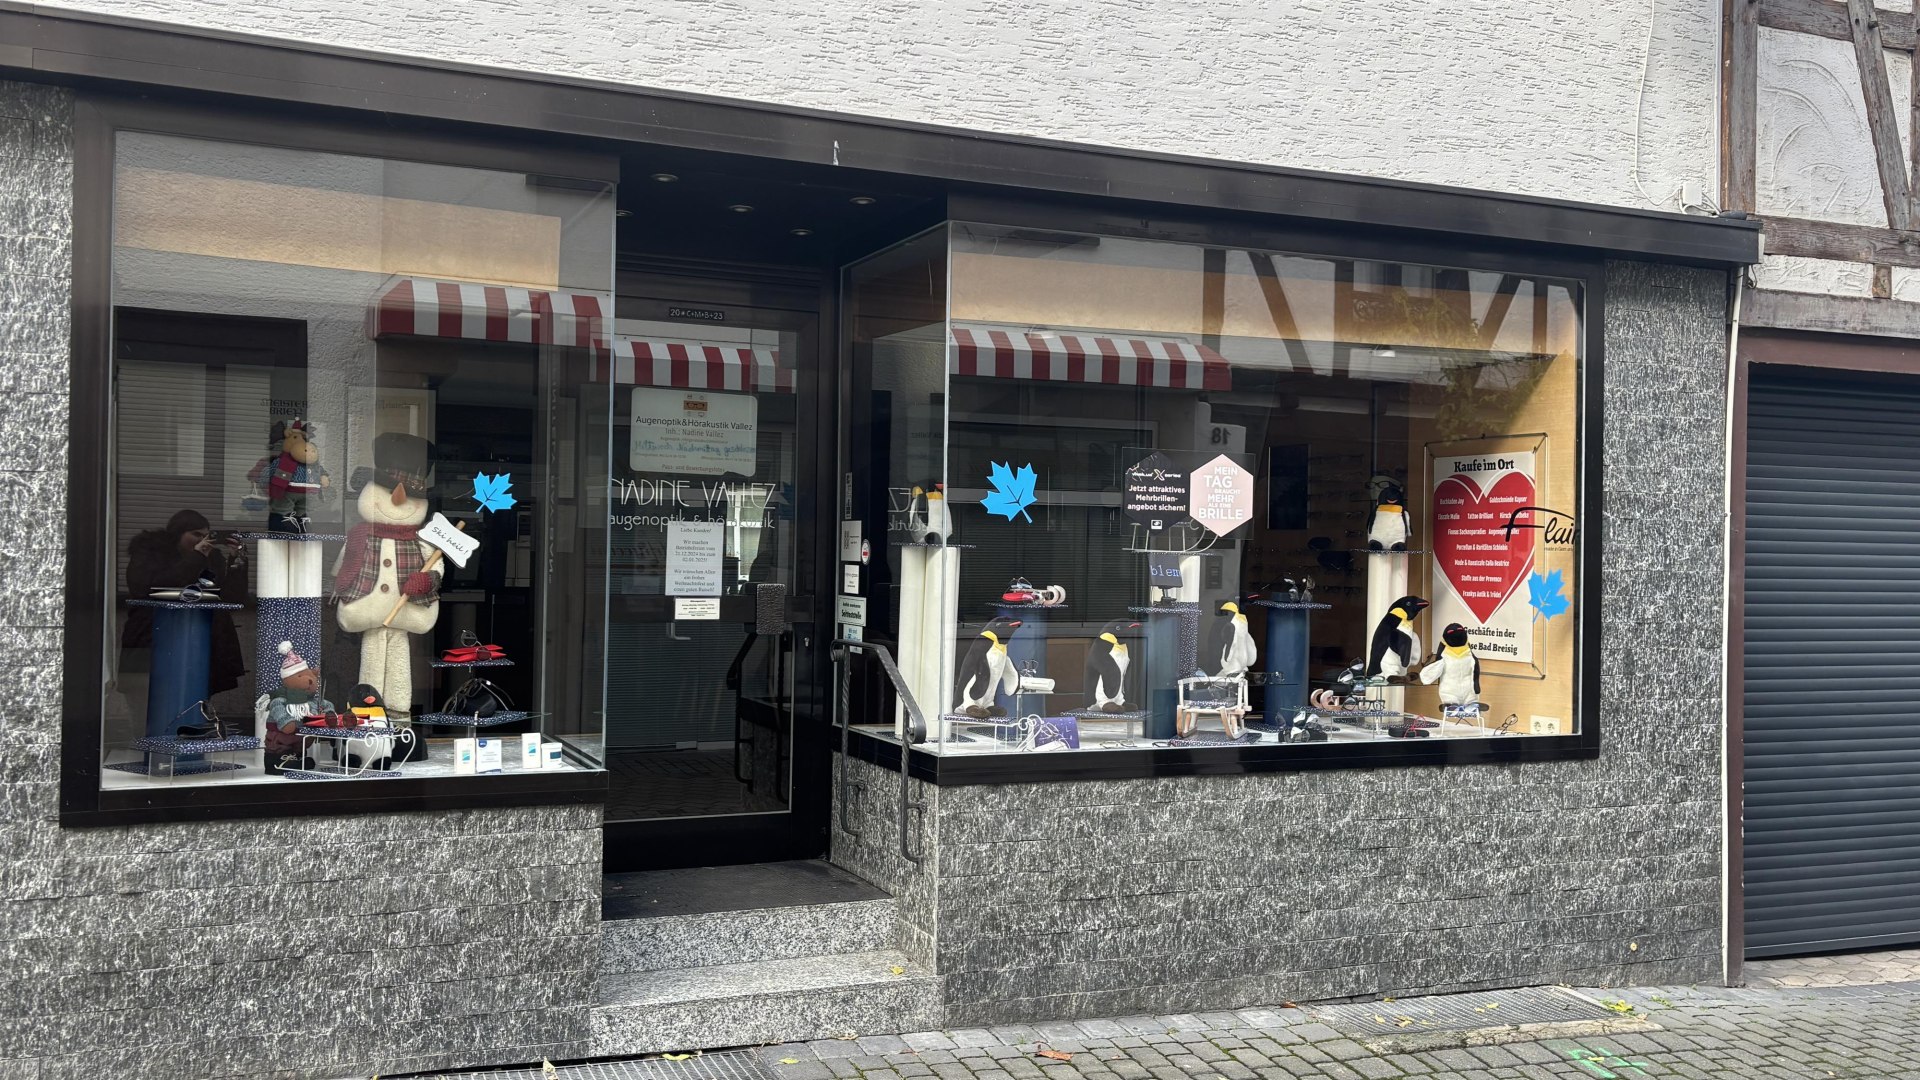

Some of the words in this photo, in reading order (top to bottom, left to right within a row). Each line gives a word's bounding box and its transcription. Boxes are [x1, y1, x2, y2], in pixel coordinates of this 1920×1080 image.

[730, 422, 753, 431] Vallez
[682, 429, 704, 437] Nadine
[706, 430, 725, 438] Vallez
[1454, 459, 1482, 473] Kaufe
[1483, 458, 1496, 471] im
[1498, 458, 1515, 470] Ort
[1214, 466, 1238, 476] MEIN
[1203, 474, 1233, 489] TAG
[1148, 485, 1186, 494] attraktives
[1135, 494, 1179, 503] Mehrbrillen-
[1207, 493, 1235, 504] MEHR
[1127, 503, 1157, 512] angebot
[1158, 504, 1186, 512] sichern!
[1198, 507, 1243, 520] BRILLE
[431, 526, 446, 539] Ski
[1496, 628, 1504, 637] in
[1504, 629, 1516, 638] der
[1478, 642, 1493, 651] Bad
[1492, 643, 1519, 656] Breisig
